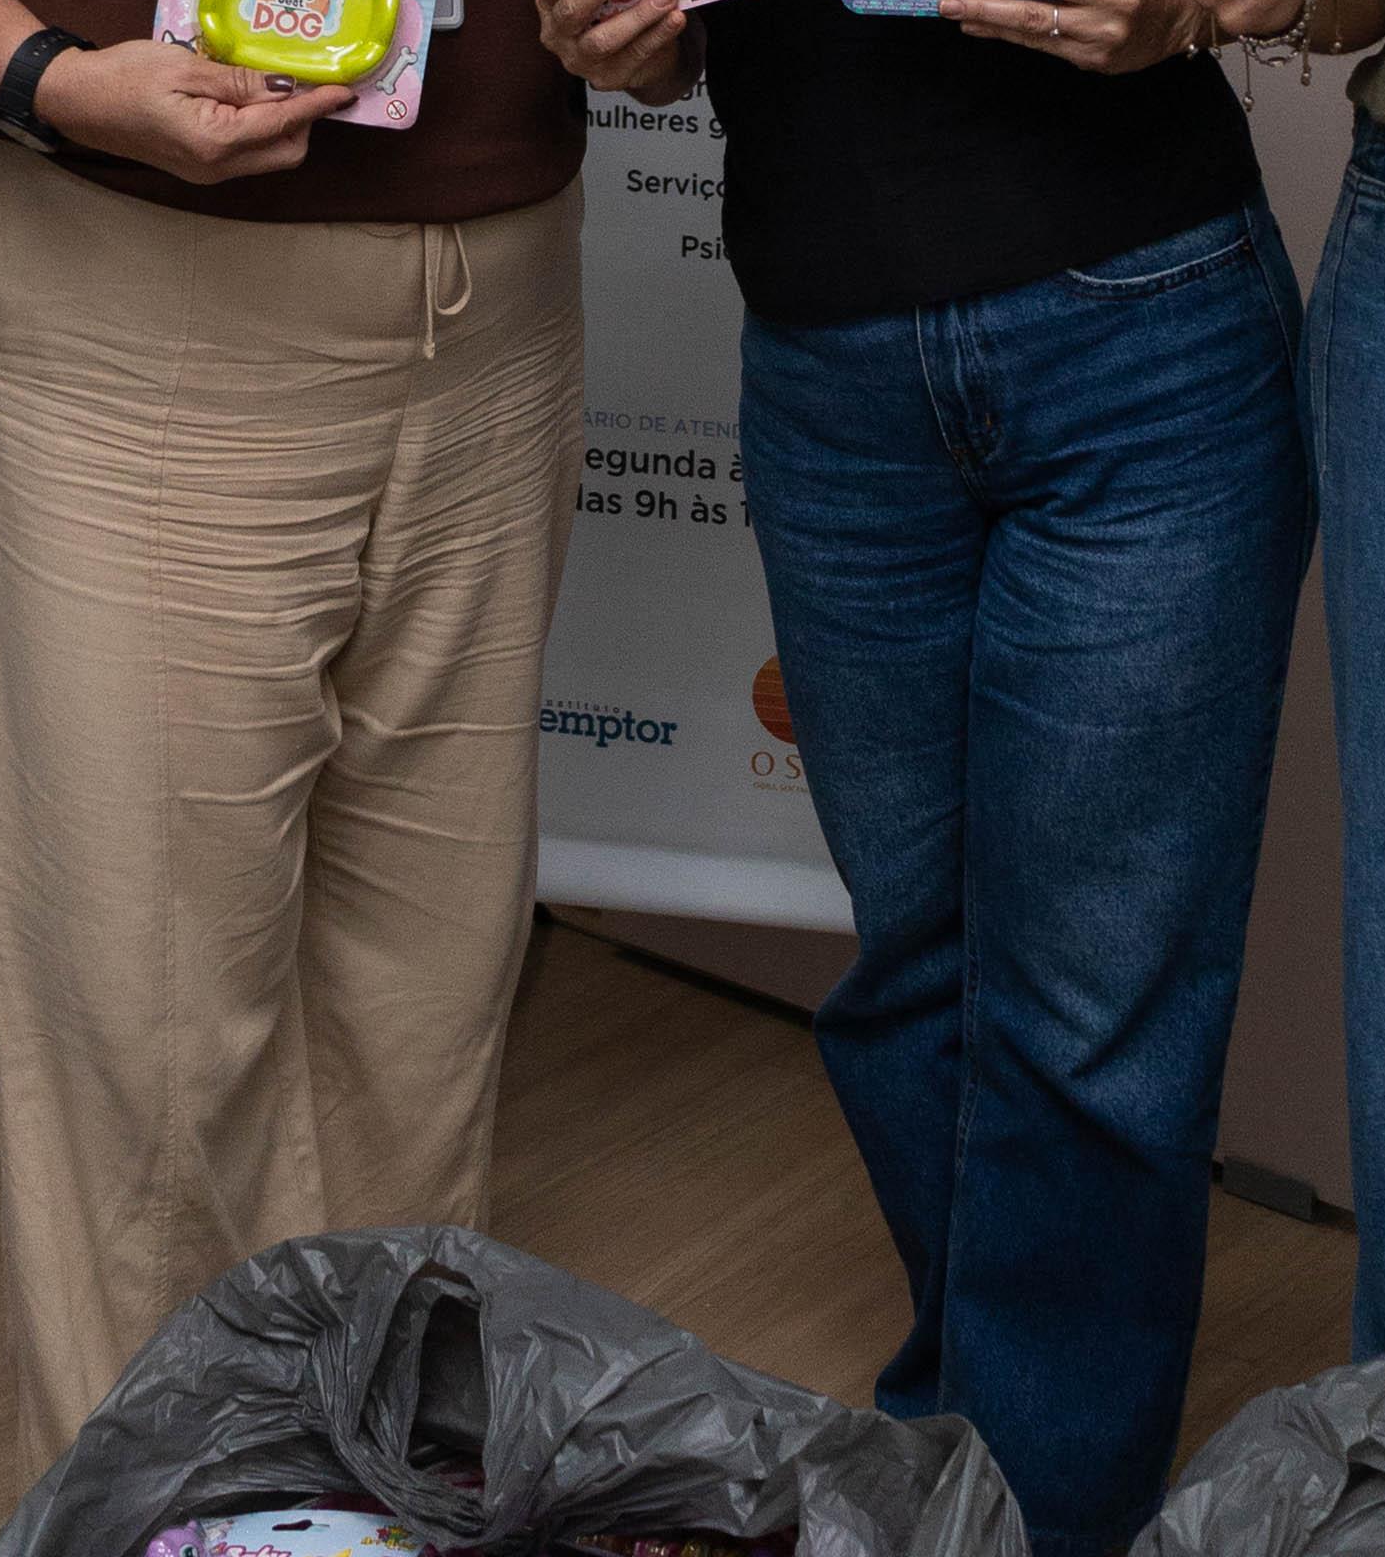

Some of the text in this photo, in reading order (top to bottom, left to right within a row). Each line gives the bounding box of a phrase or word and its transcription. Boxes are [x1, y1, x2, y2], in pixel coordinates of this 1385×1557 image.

[252, 3, 324, 39] DOG
[584, 411, 633, 431] ÁRIO
[639, 414, 668, 434] DE
[585, 446, 717, 482] egunda
[634, 489, 679, 522] 9h
[689, 491, 728, 526] às
[539, 707, 678, 748] emptor
